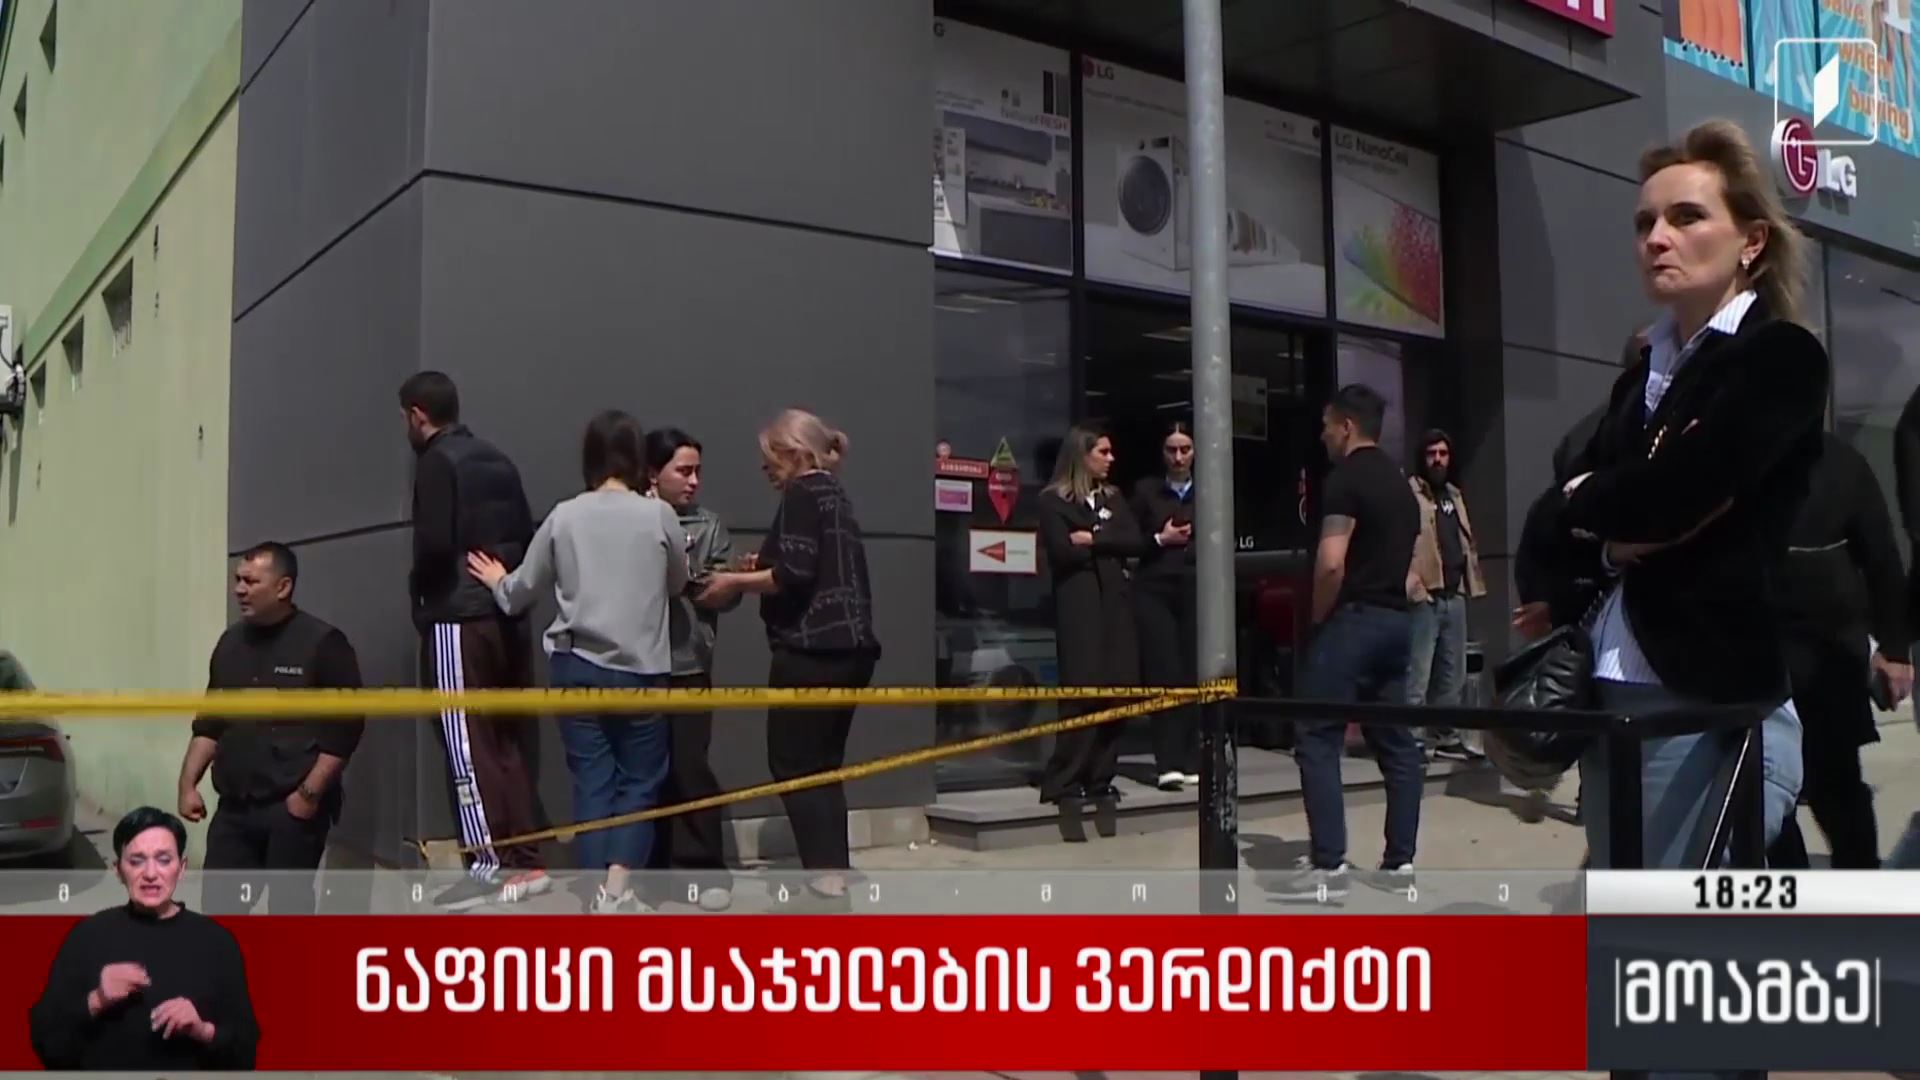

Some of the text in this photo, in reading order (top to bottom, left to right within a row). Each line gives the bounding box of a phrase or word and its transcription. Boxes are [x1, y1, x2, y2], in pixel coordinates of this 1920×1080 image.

[1097, 64, 1115, 81] LG
[1849, 84, 1909, 140] buying
[1335, 131, 1352, 150] LG
[1819, 149, 1857, 197] LG
[1239, 535, 1255, 549] LG
[274, 665, 304, 676] POLICE
